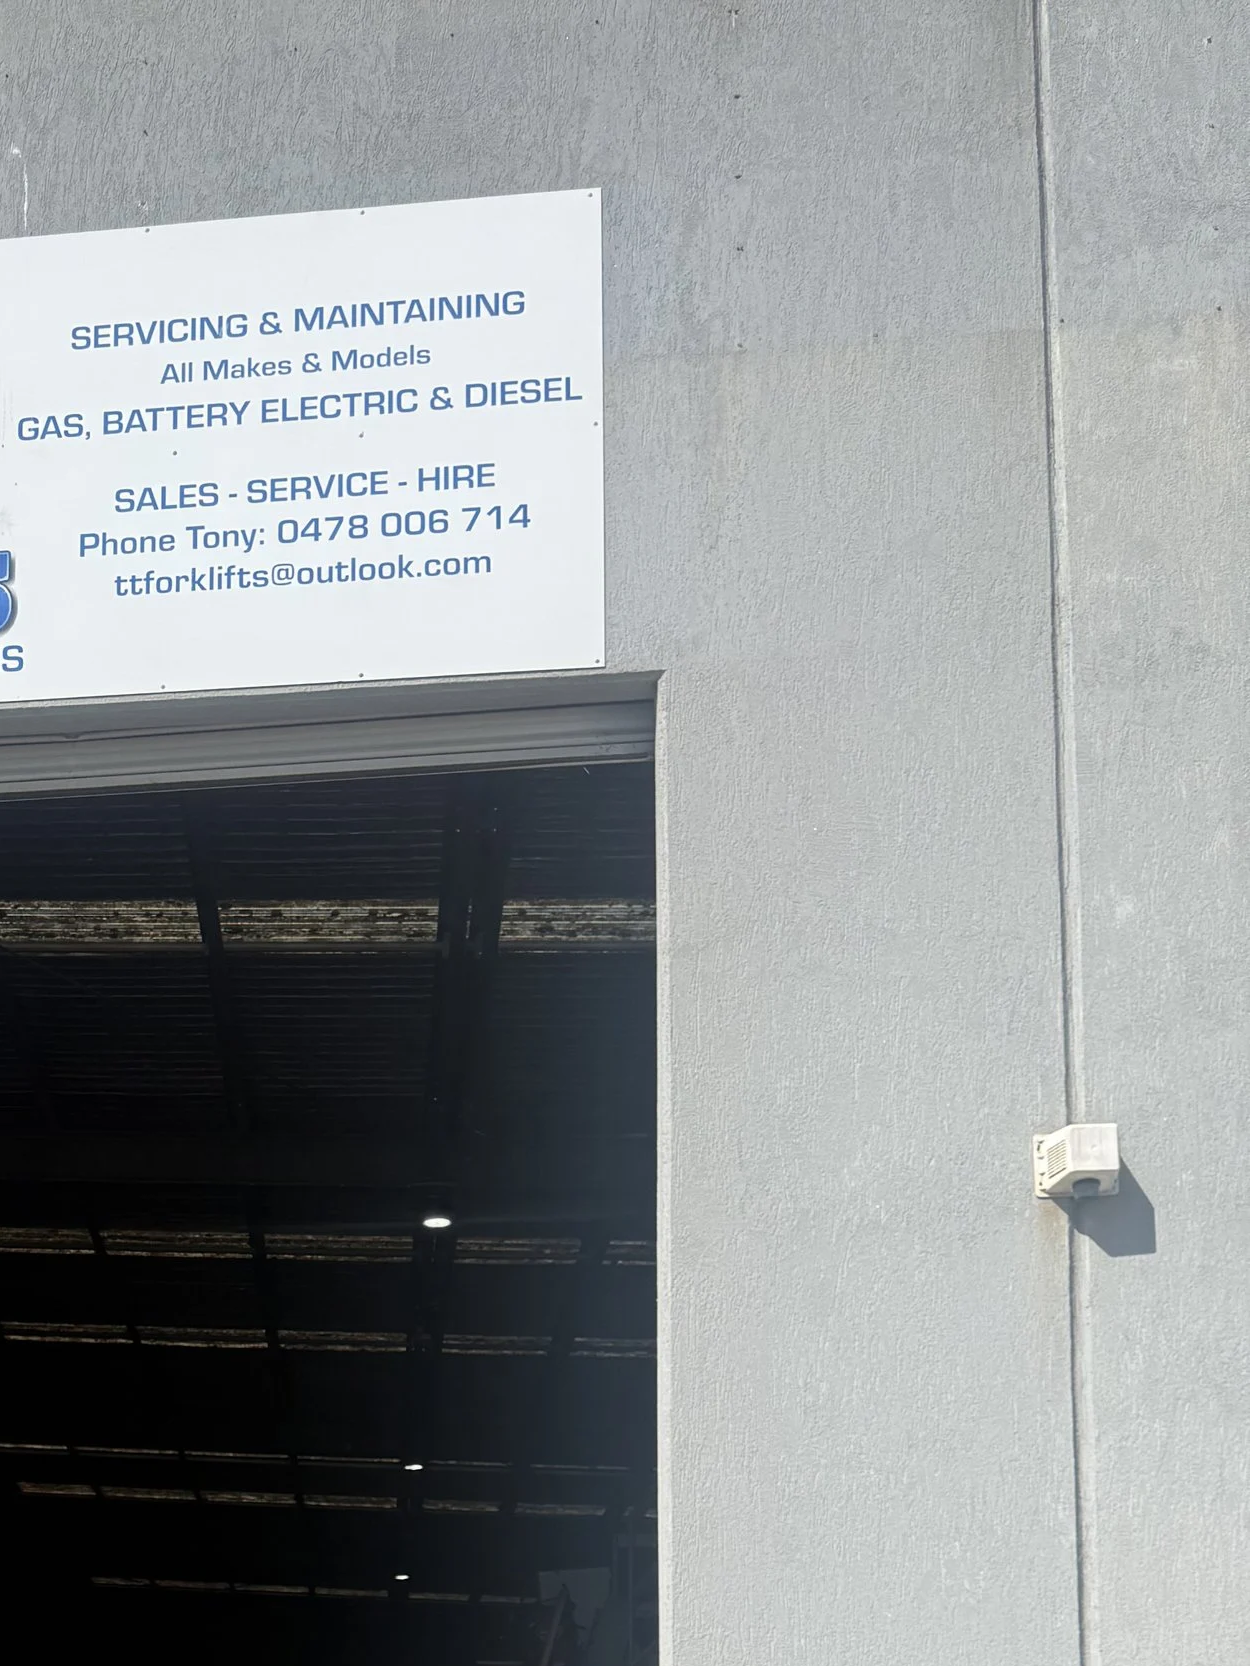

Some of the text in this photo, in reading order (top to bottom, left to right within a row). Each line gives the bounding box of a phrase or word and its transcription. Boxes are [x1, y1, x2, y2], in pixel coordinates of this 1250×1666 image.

[71, 290, 525, 350] SERVICING & MAINTAINING
[160, 344, 431, 385] All Makes & Models
[17, 376, 583, 441] GAS, BATTERY ELECTRIC & DIESEL
[114, 482, 219, 513] SALES
[247, 470, 389, 504] SERVICE
[418, 462, 496, 492] HIRE
[79, 503, 531, 558] Phone Tony: 0478 006 714
[114, 554, 491, 596] ttforklifts@outlook.com
